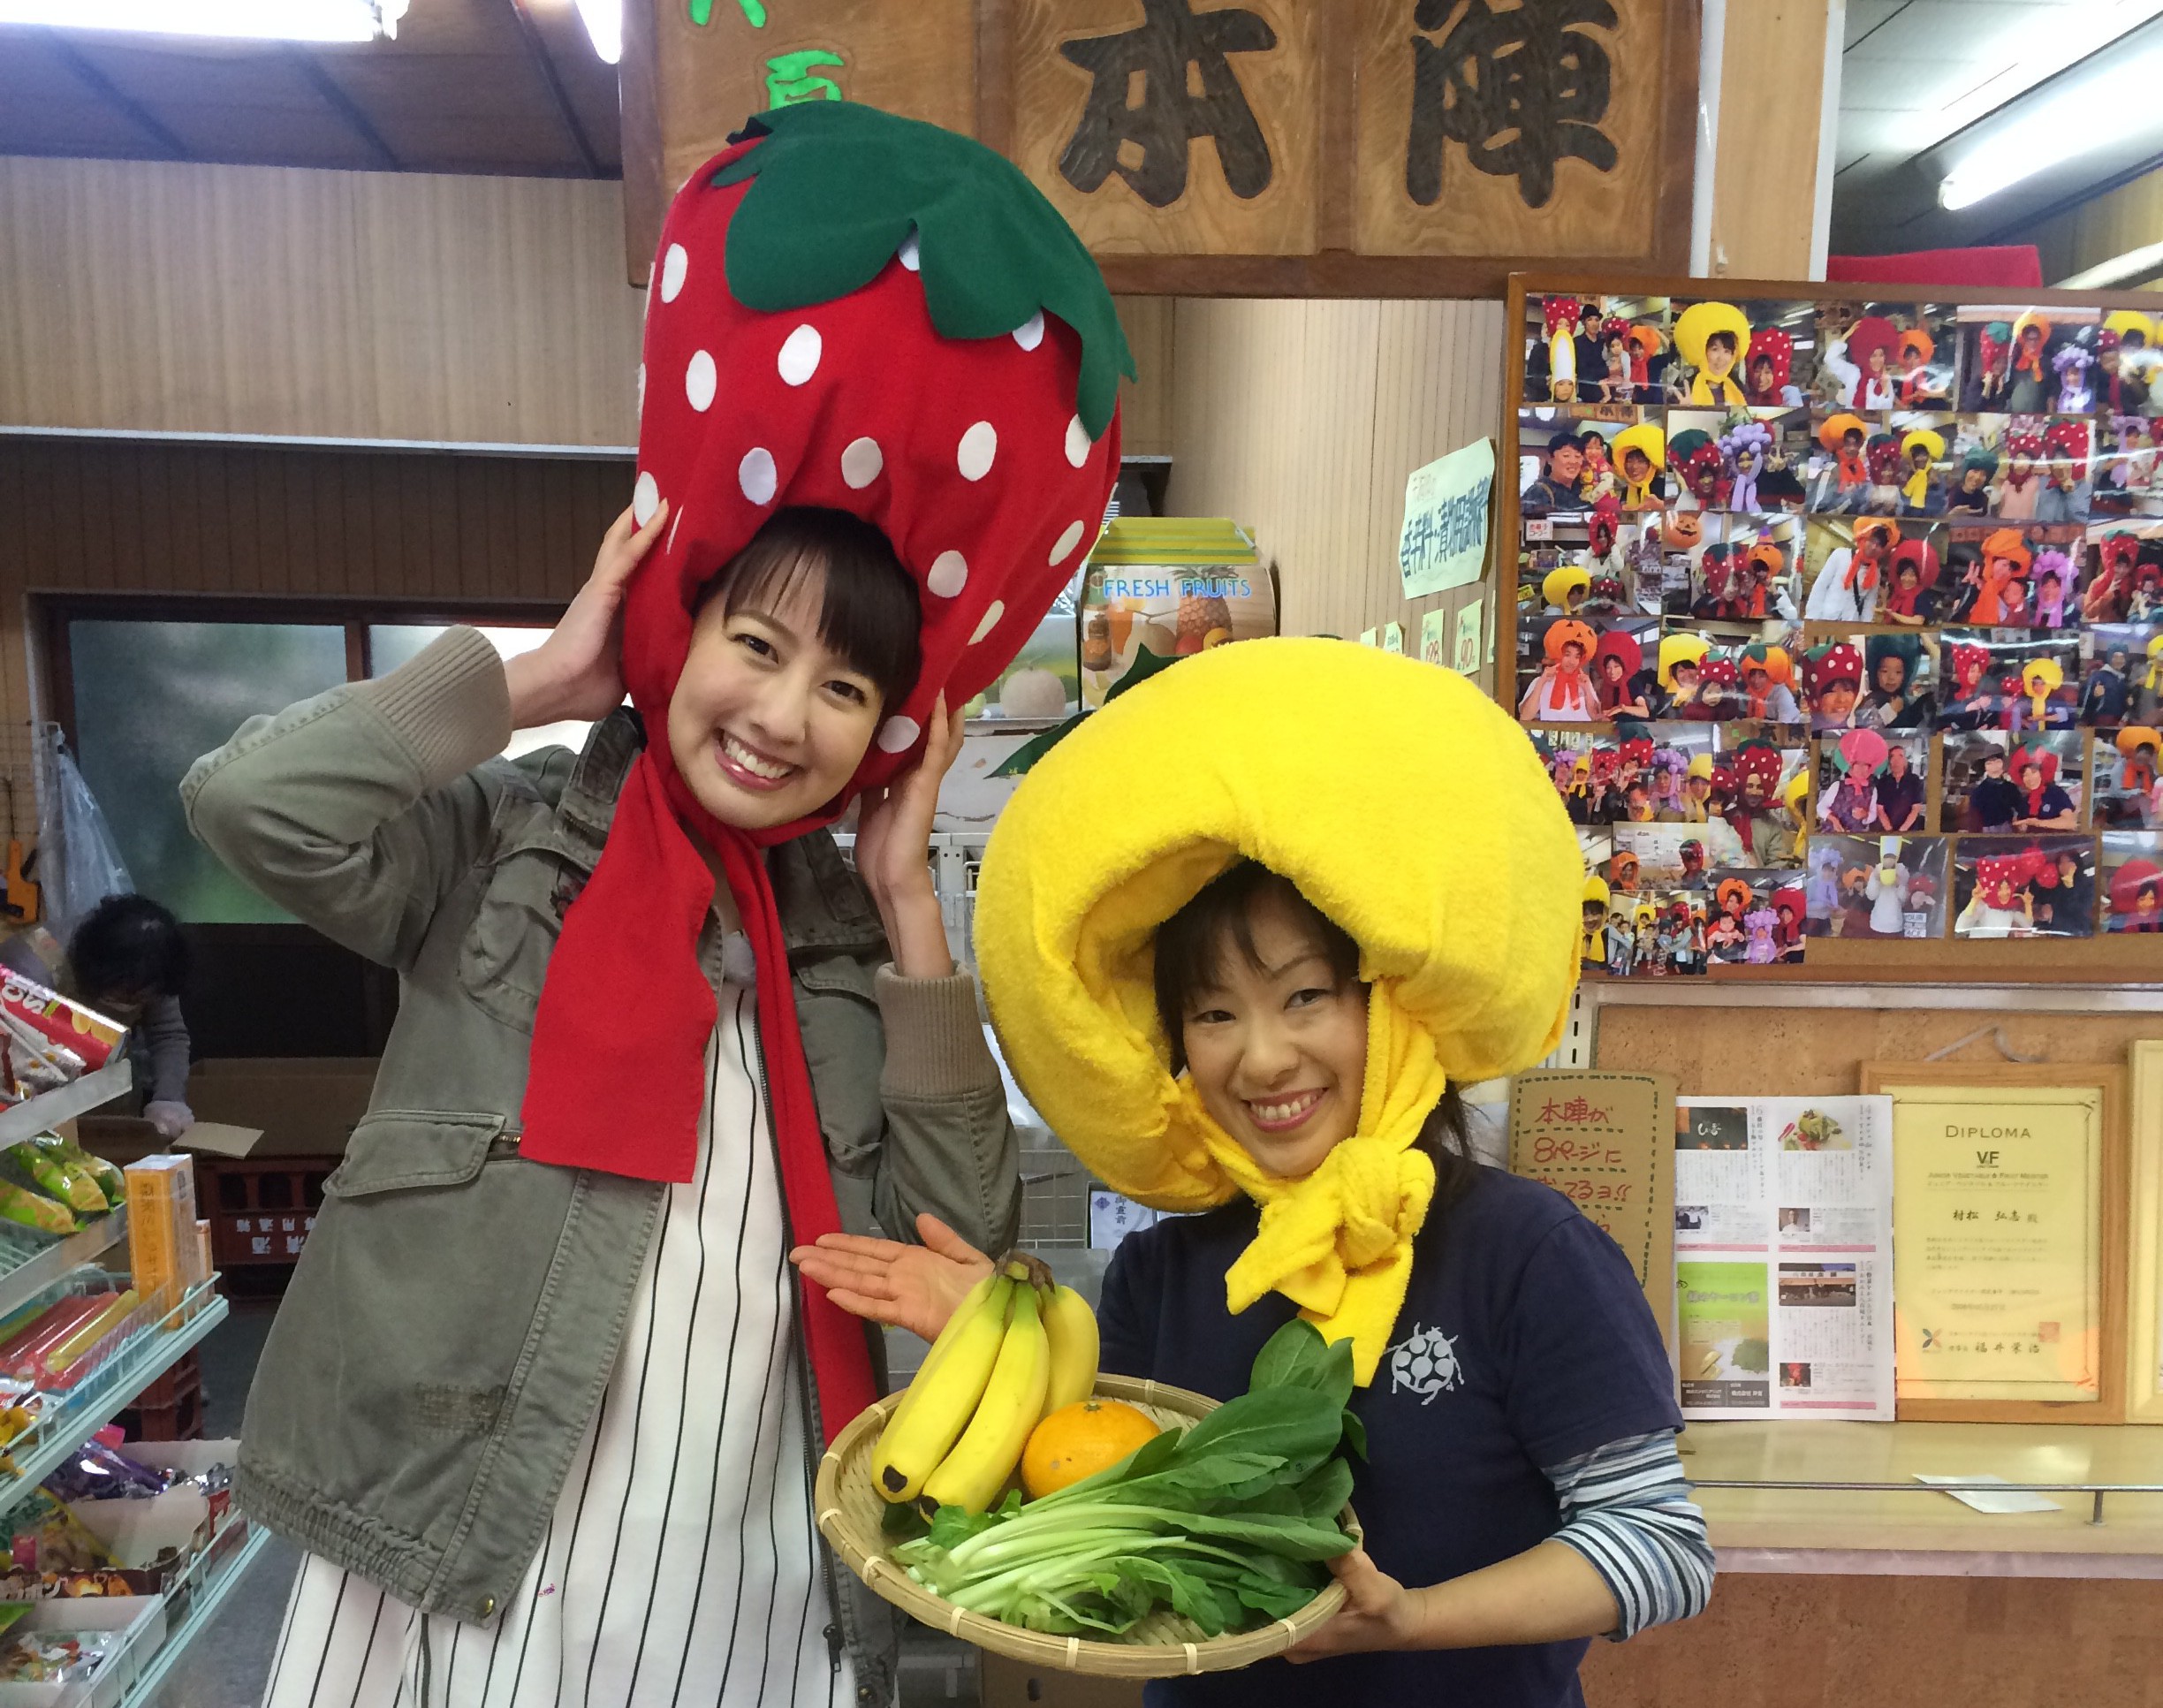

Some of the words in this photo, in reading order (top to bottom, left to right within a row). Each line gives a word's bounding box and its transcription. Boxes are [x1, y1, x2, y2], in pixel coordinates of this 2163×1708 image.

[1104, 579, 1170, 598] FRESH
[1181, 579, 1252, 598] FRUITS
[1535, 1096, 1613, 1125] 本陣が
[1534, 1137, 1622, 1164] 8ページに
[1976, 1150, 2000, 1165] VF
